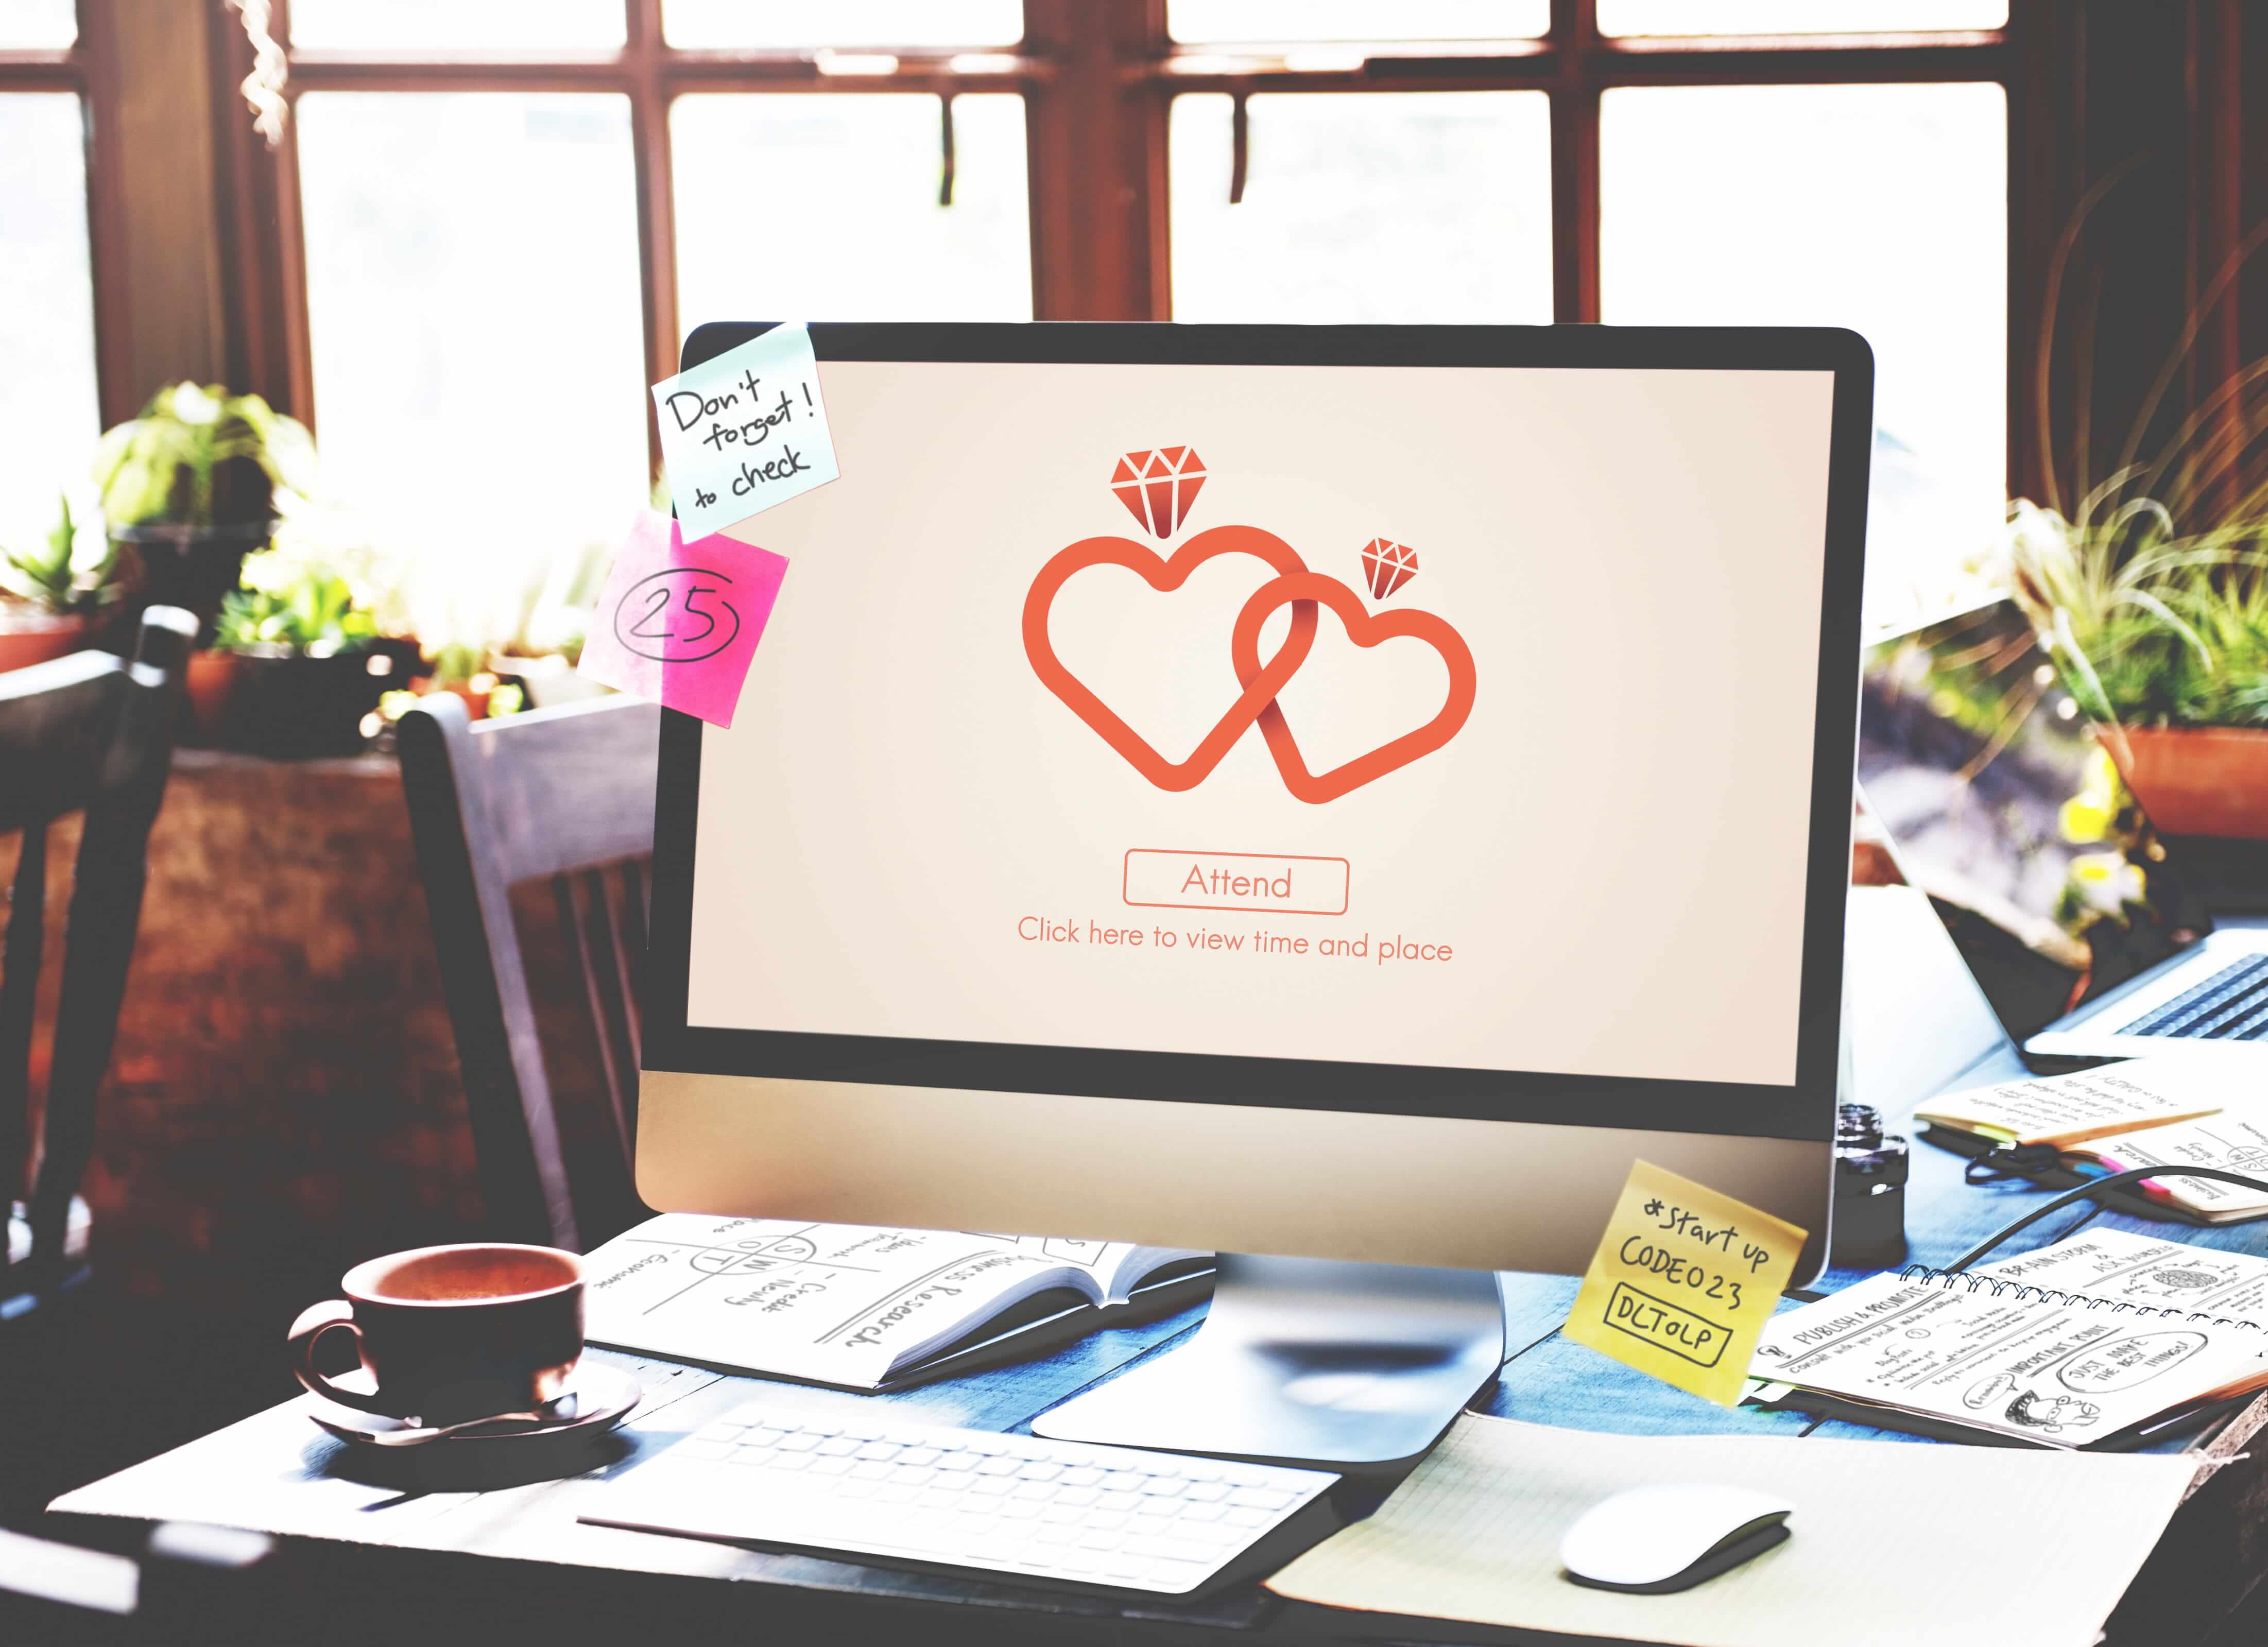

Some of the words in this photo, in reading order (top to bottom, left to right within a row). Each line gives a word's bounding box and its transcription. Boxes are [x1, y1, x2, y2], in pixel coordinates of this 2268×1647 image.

[665, 370, 760, 431] Don't
[695, 488, 717, 508] to
[732, 444, 811, 496] check
[630, 586, 716, 642] 25
[1181, 864, 1291, 899] Attend
[1018, 916, 1080, 943] Click
[1089, 920, 1144, 946] here
[1154, 924, 1177, 948] to
[1186, 928, 1245, 951] view
[1254, 931, 1309, 954] time
[1319, 933, 1368, 957] and
[1378, 935, 1453, 965] place
[1743, 1243, 1768, 1273] up
[846, 1285, 962, 1347] Research
[1793, 1316, 1864, 1345] PUBLISH
[2005, 1342, 2076, 1374] IMPORTANT
[2069, 1359, 2106, 1379] JUST
[2093, 1368, 2120, 1381] THE
[2118, 1352, 2148, 1367] BEST
